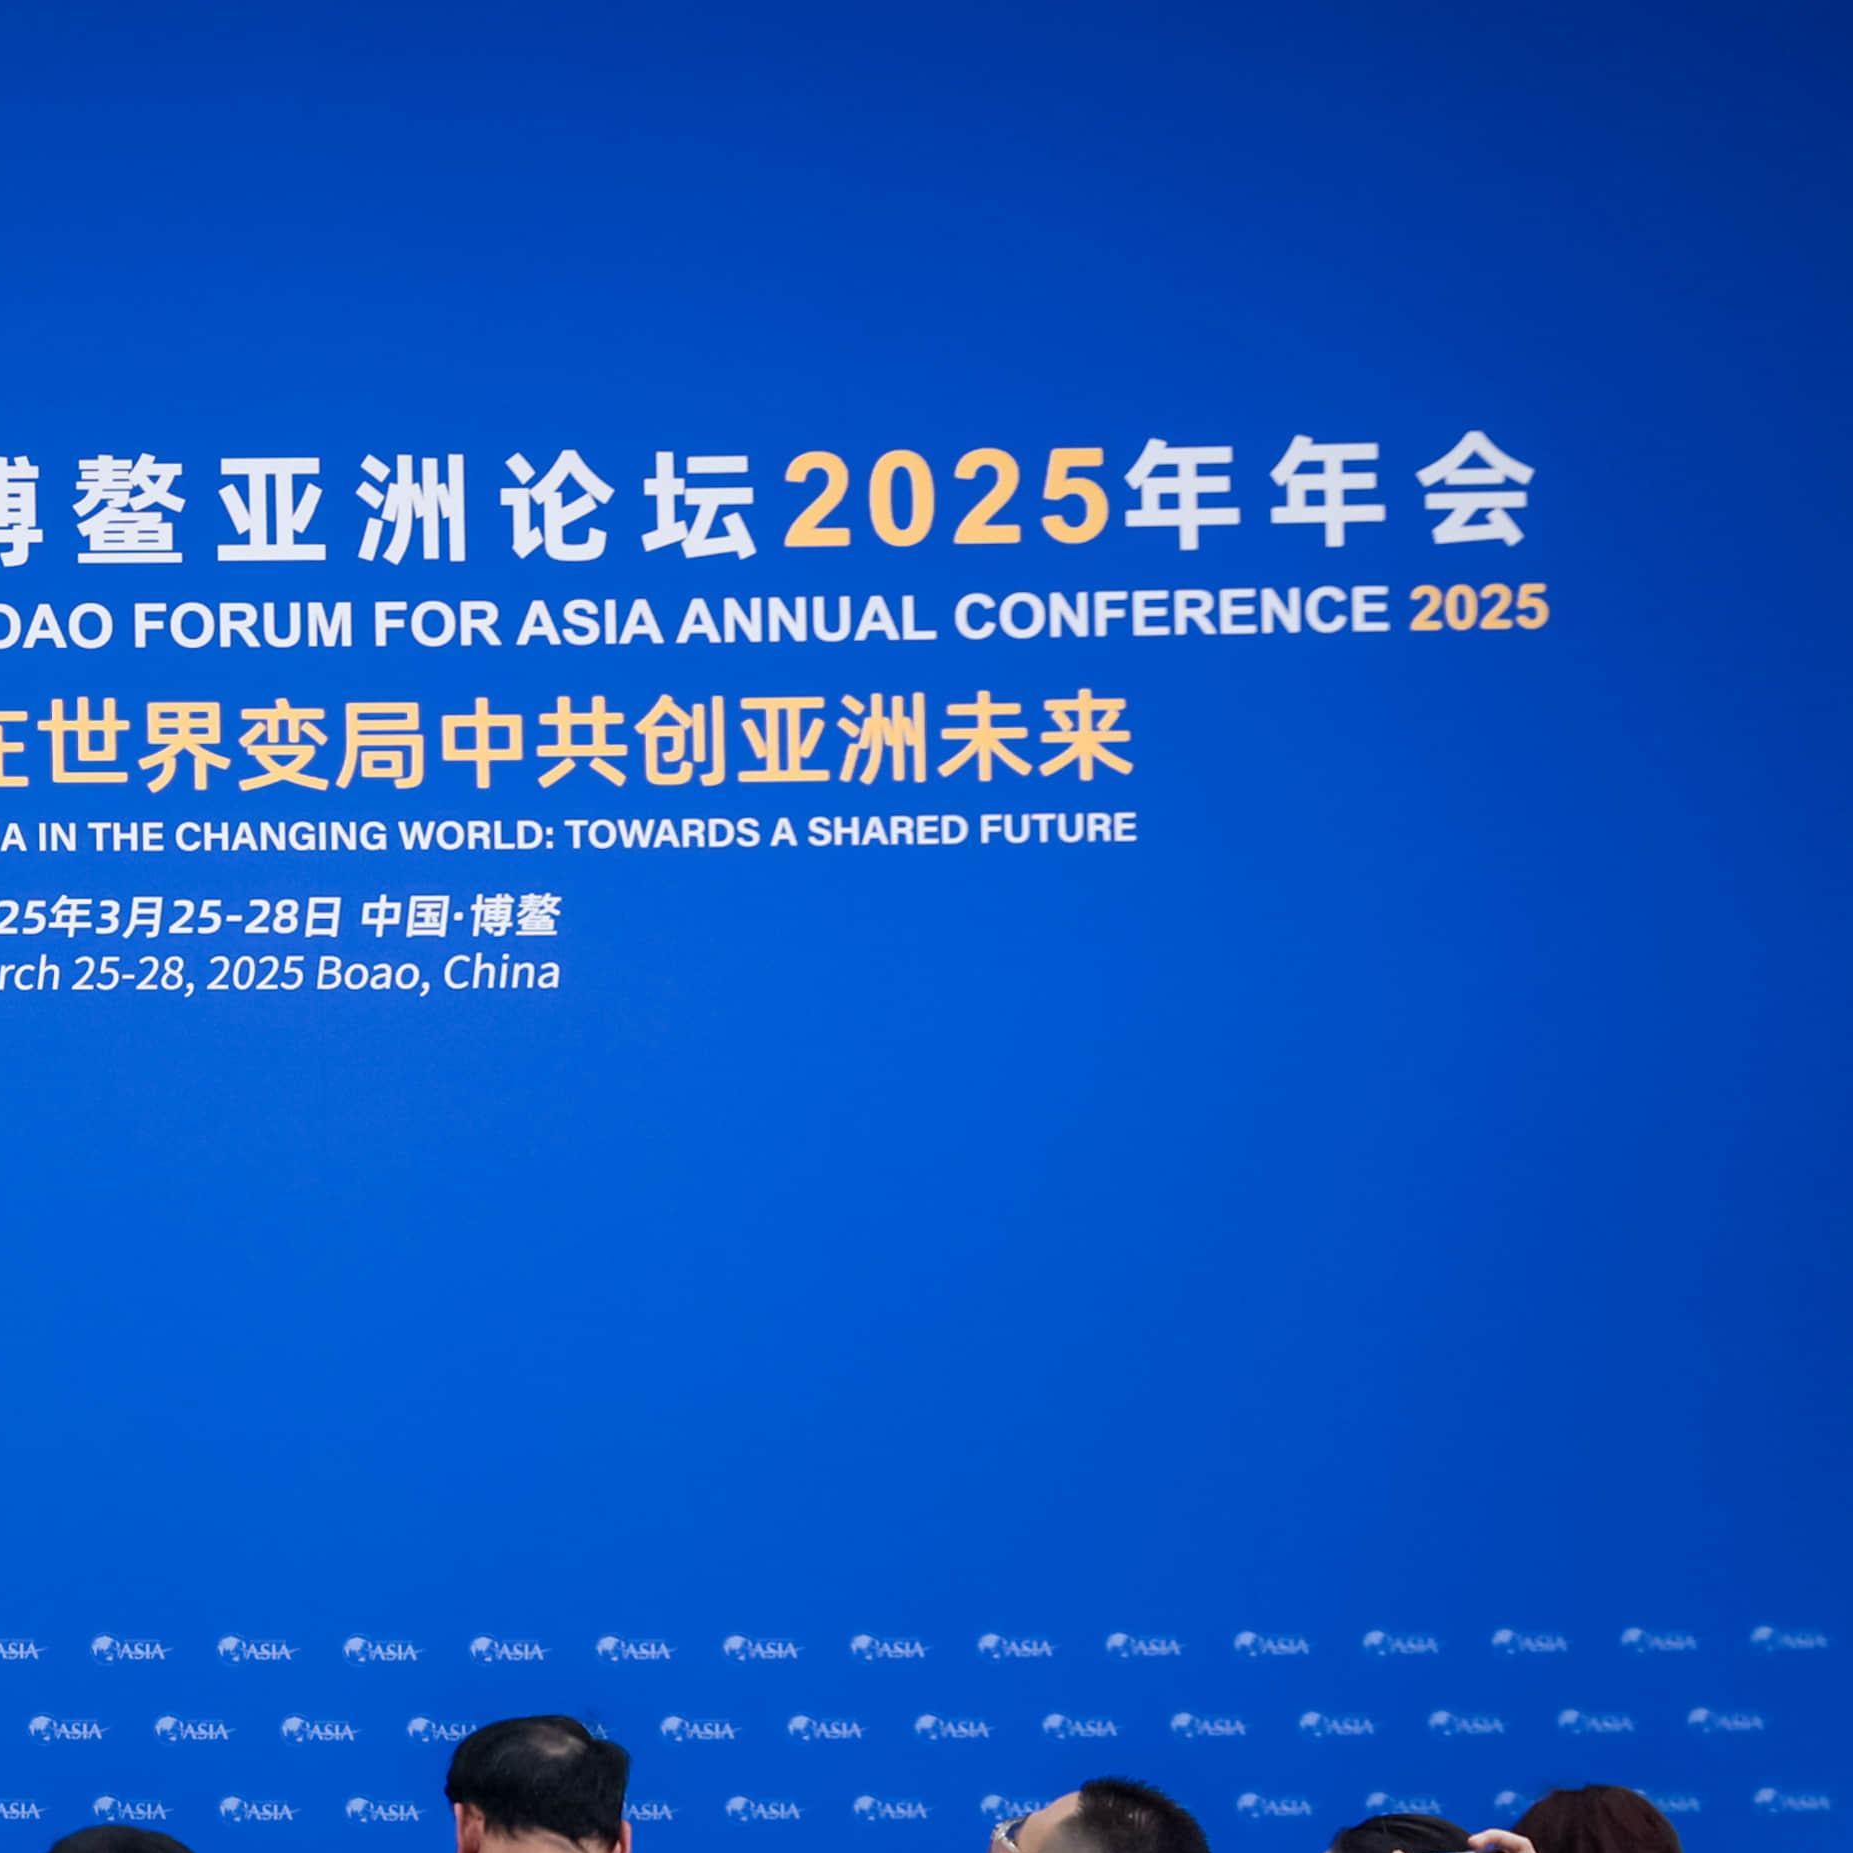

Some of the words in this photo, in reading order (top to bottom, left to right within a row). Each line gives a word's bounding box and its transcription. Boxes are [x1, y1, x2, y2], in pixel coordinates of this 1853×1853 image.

[135, 602, 352, 649] FORUM
[375, 600, 501, 647] FOR
[517, 599, 665, 645] ASIA
[676, 595, 937, 644] ANNUAL
[954, 586, 1390, 640] CONFERENCE
[1410, 583, 1550, 631] 2025
[39, 823, 77, 852] IN
[88, 822, 164, 852] THE
[175, 821, 387, 852] CHANGING
[398, 820, 554, 851] WORLD:
[565, 818, 761, 849] TOWARDS
[770, 818, 798, 847] A
[808, 815, 969, 847] SHARED
[980, 813, 1137, 844] FUTURE
[71, 955, 196, 998] 25-28,
[207, 955, 305, 990] 2025
[317, 955, 430, 998] Boao,
[444, 953, 560, 990] China
[119, 1642, 165, 1660] ASIA
[245, 1643, 291, 1661] ASIA
[371, 1643, 417, 1661] ASIA
[498, 1643, 544, 1661] ASIA
[624, 1642, 670, 1660] ASIA
[56, 1722, 102, 1740] ASIA
[183, 1723, 229, 1741] ASIA
[309, 1723, 355, 1741] ASIA
[689, 1722, 735, 1740] ASIA
[247, 1803, 293, 1821] ASIA
[373, 1804, 419, 1822] ASIA
